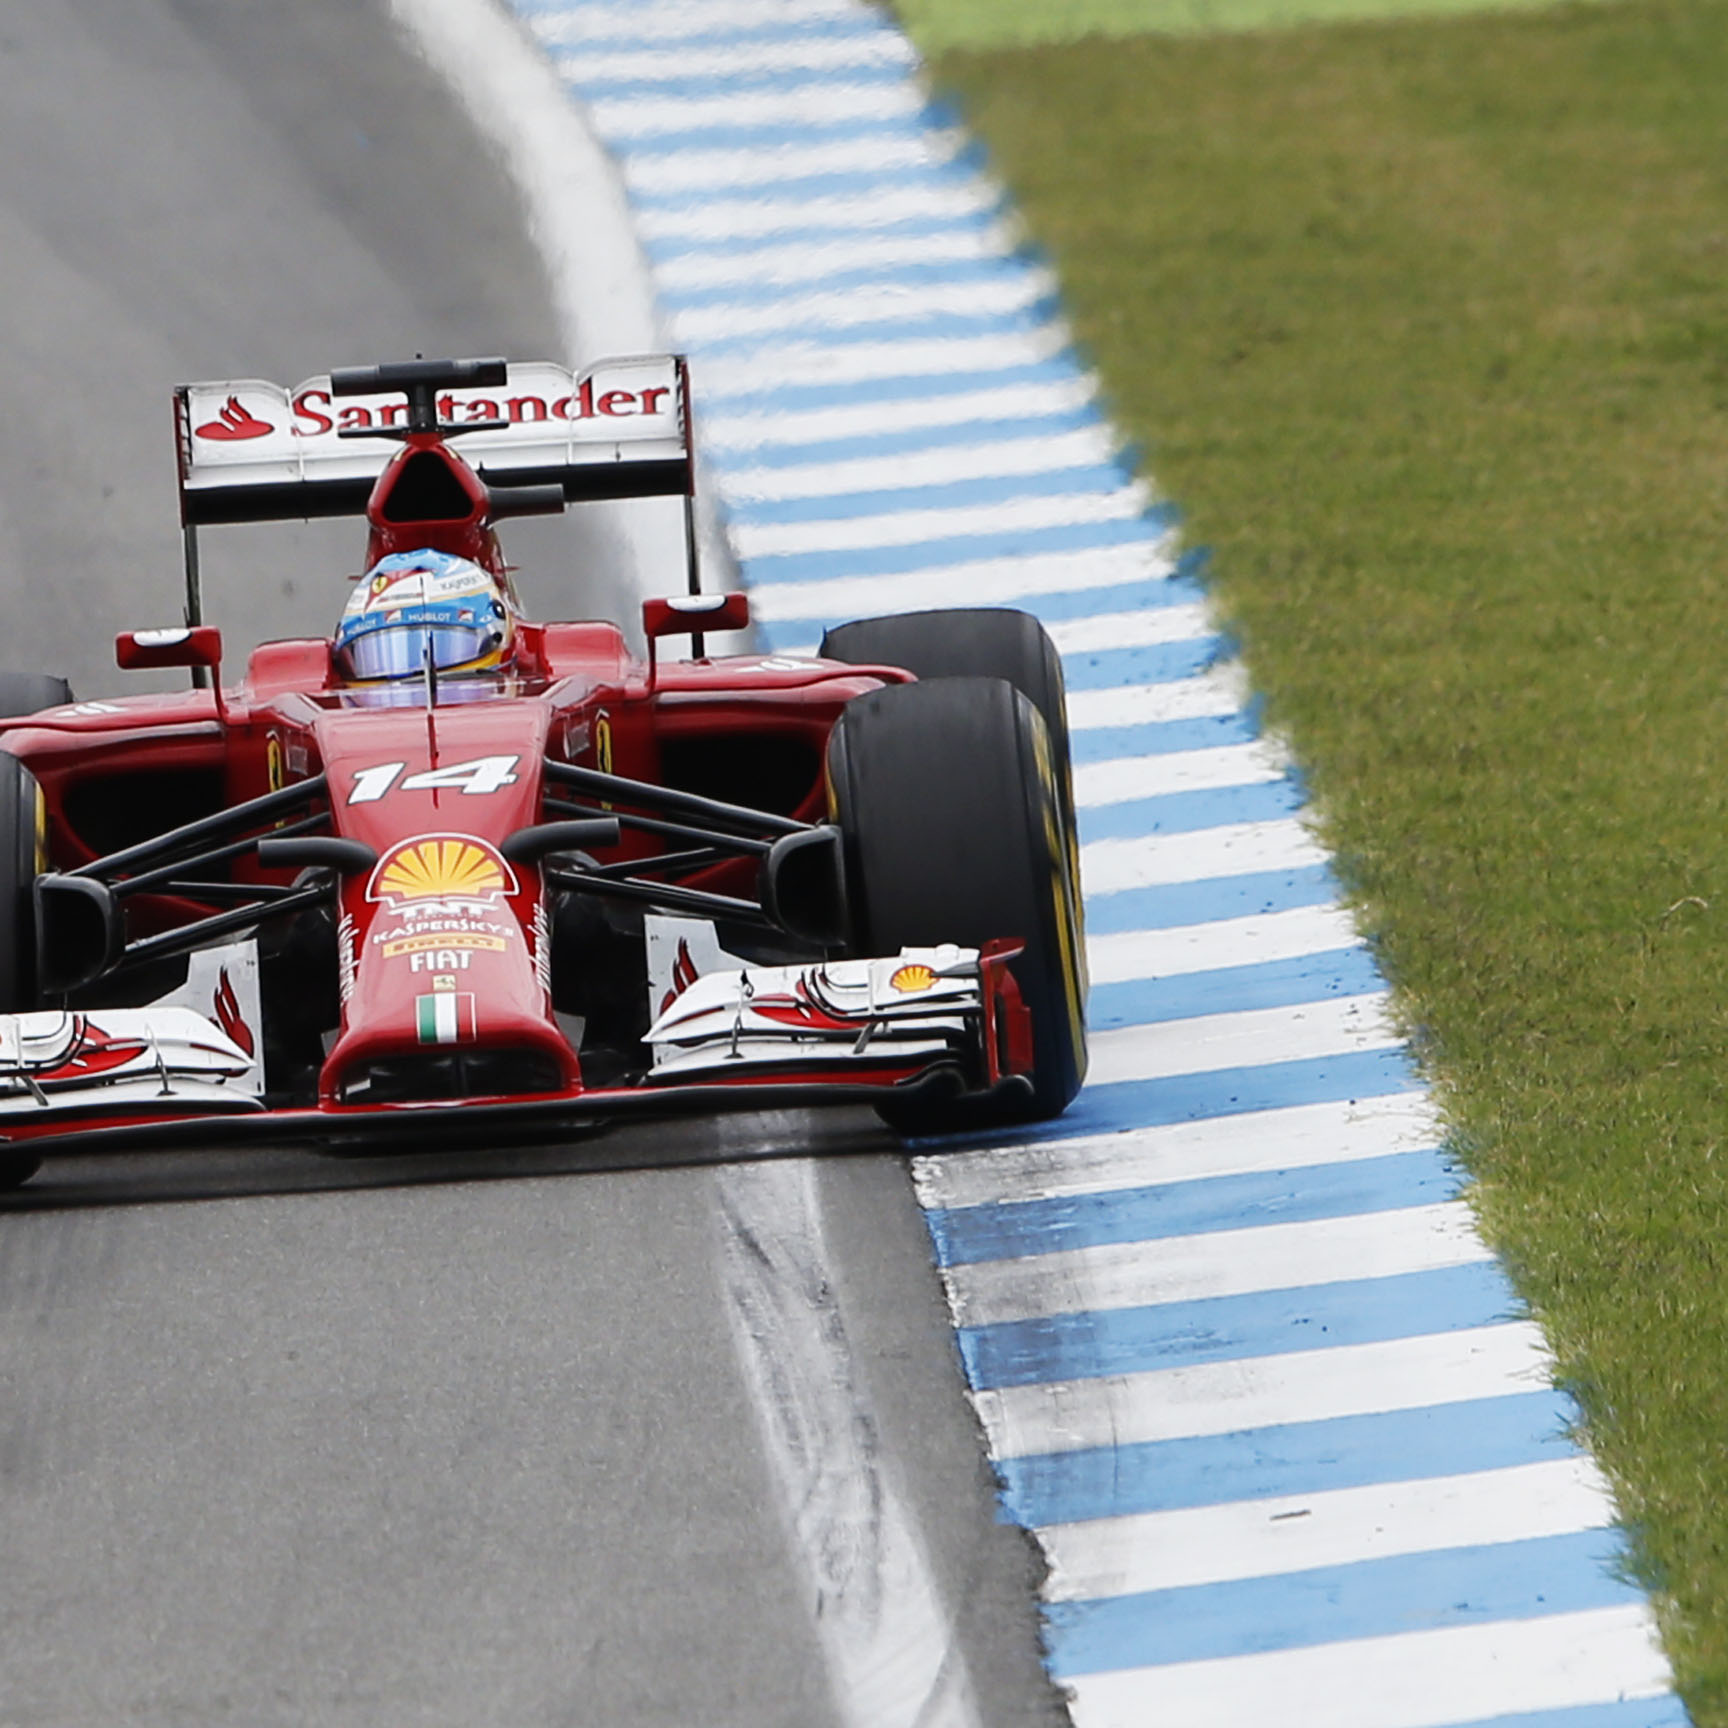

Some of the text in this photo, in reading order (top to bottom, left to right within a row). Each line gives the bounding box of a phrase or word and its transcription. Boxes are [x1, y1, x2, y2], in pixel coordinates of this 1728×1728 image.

[290, 376, 670, 437] Santander
[347, 754, 521, 806] 14
[409, 949, 473, 973] FIAT
